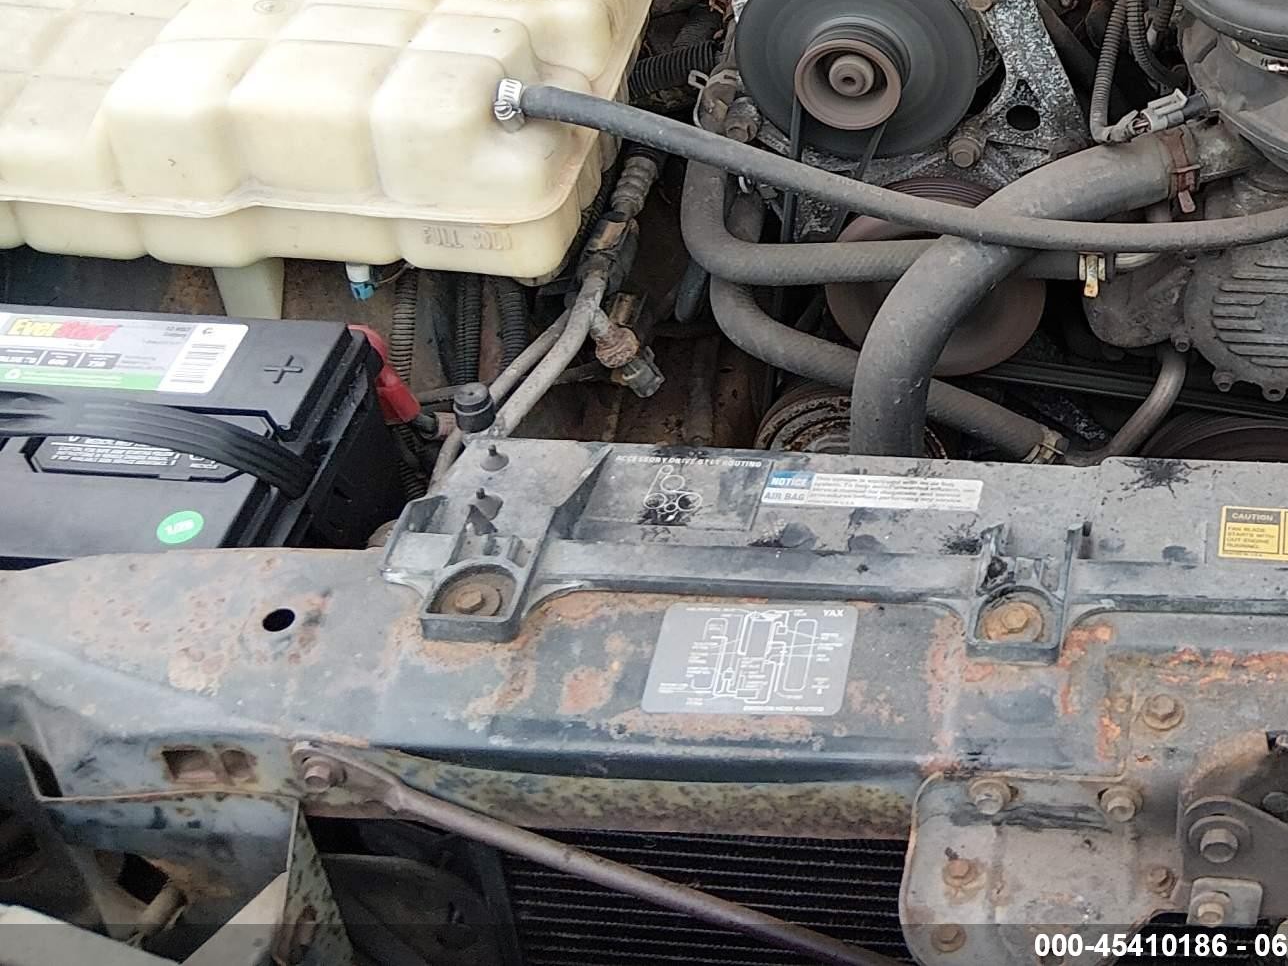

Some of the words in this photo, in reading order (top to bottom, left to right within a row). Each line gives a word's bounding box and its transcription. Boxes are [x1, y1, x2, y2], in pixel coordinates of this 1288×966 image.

[771, 477, 808, 487] NOTICE
[763, 491, 781, 500] AIR
[783, 492, 805, 501] BAG
[1231, 512, 1274, 521] CAUTION
